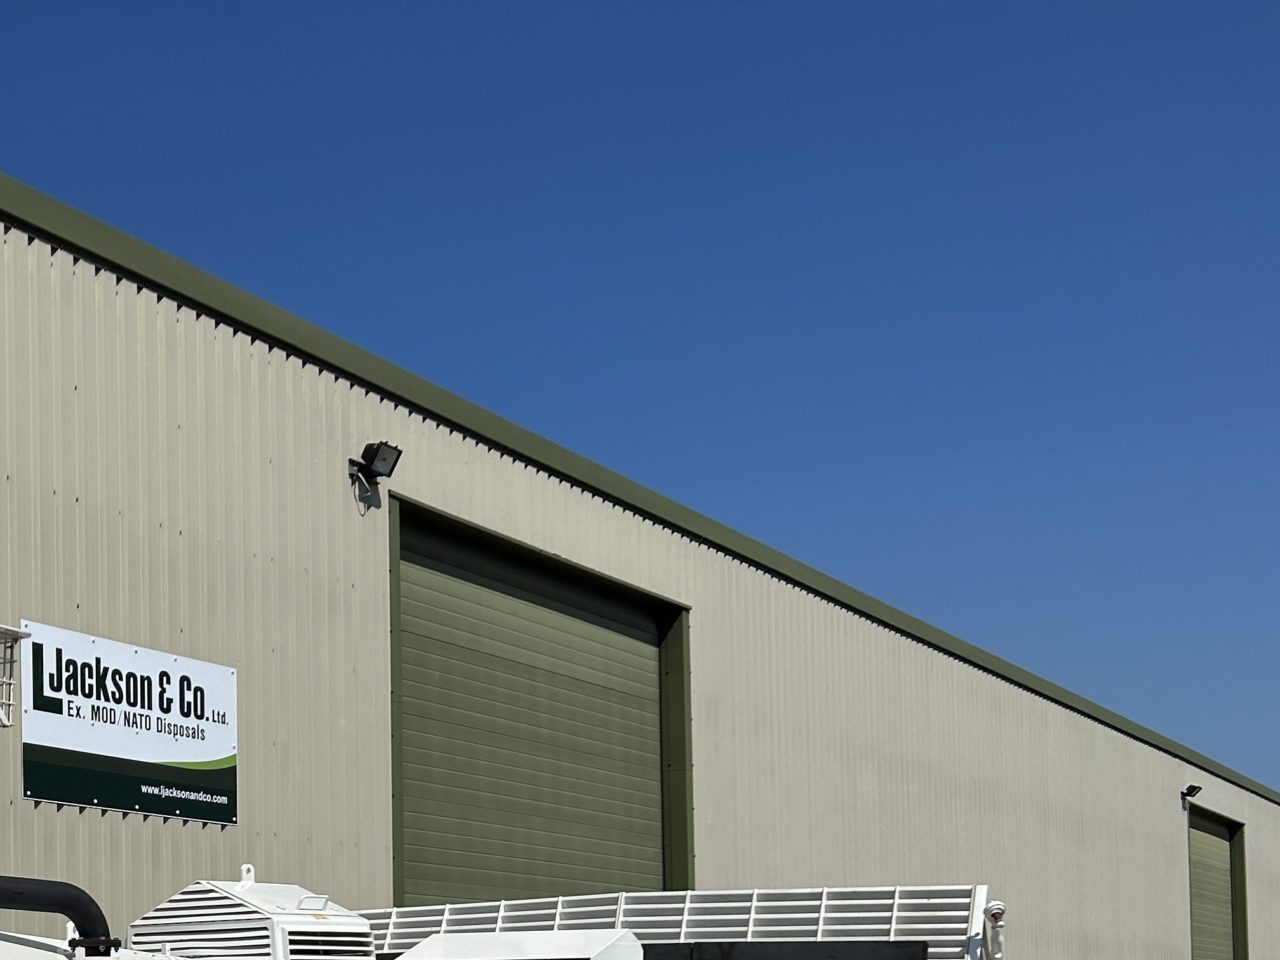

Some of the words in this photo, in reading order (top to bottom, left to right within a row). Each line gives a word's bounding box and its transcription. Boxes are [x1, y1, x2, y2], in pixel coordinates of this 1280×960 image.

[158, 671, 174, 714] &
[179, 675, 210, 722] Co.
[211, 709, 230, 726] Ltd.
[67, 700, 86, 720] Ex.
[91, 704, 152, 731] MOD/NATO
[156, 718, 206, 741] Disposals
[141, 784, 228, 805] www.ljacksonandco.com
